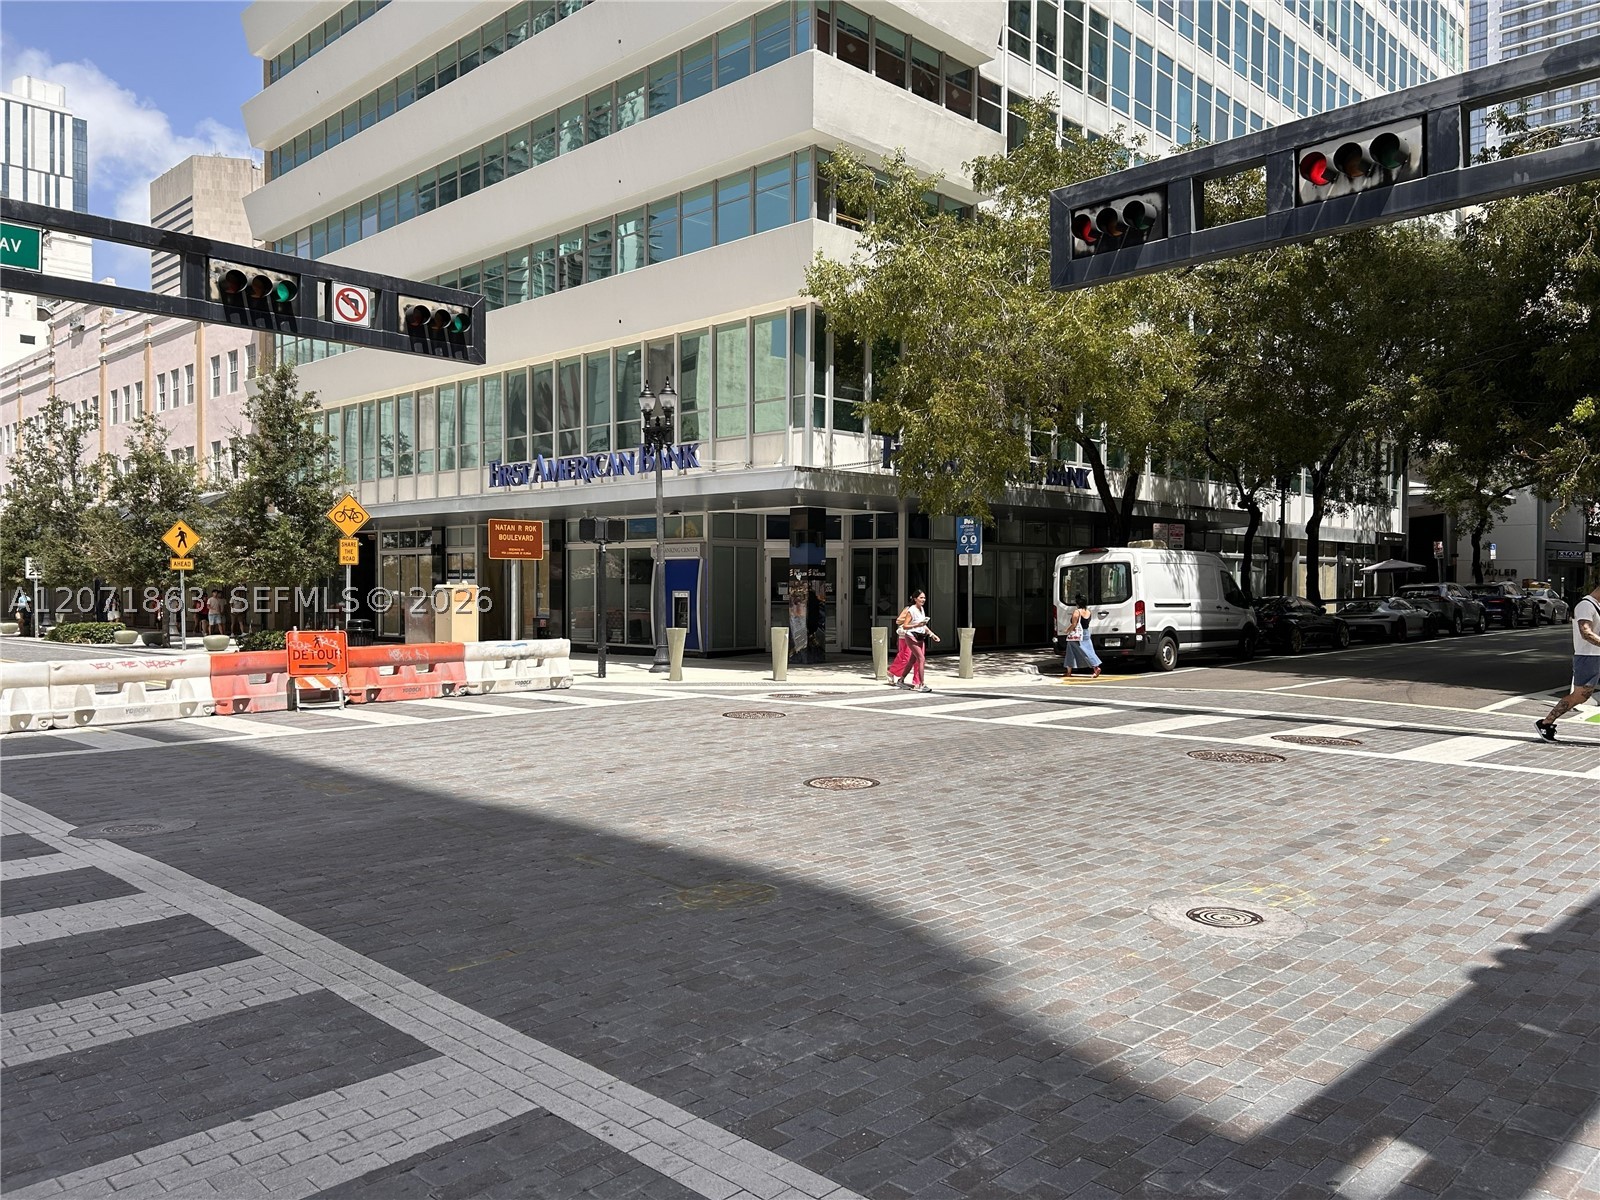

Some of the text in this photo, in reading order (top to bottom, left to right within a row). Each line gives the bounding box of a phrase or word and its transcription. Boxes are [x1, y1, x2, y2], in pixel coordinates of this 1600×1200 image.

[0, 237, 22, 253] AV
[488, 443, 700, 487] FIRST AMERICAN BANK
[498, 533, 534, 541] BOULEVARD
[292, 649, 343, 660] DETOUR
